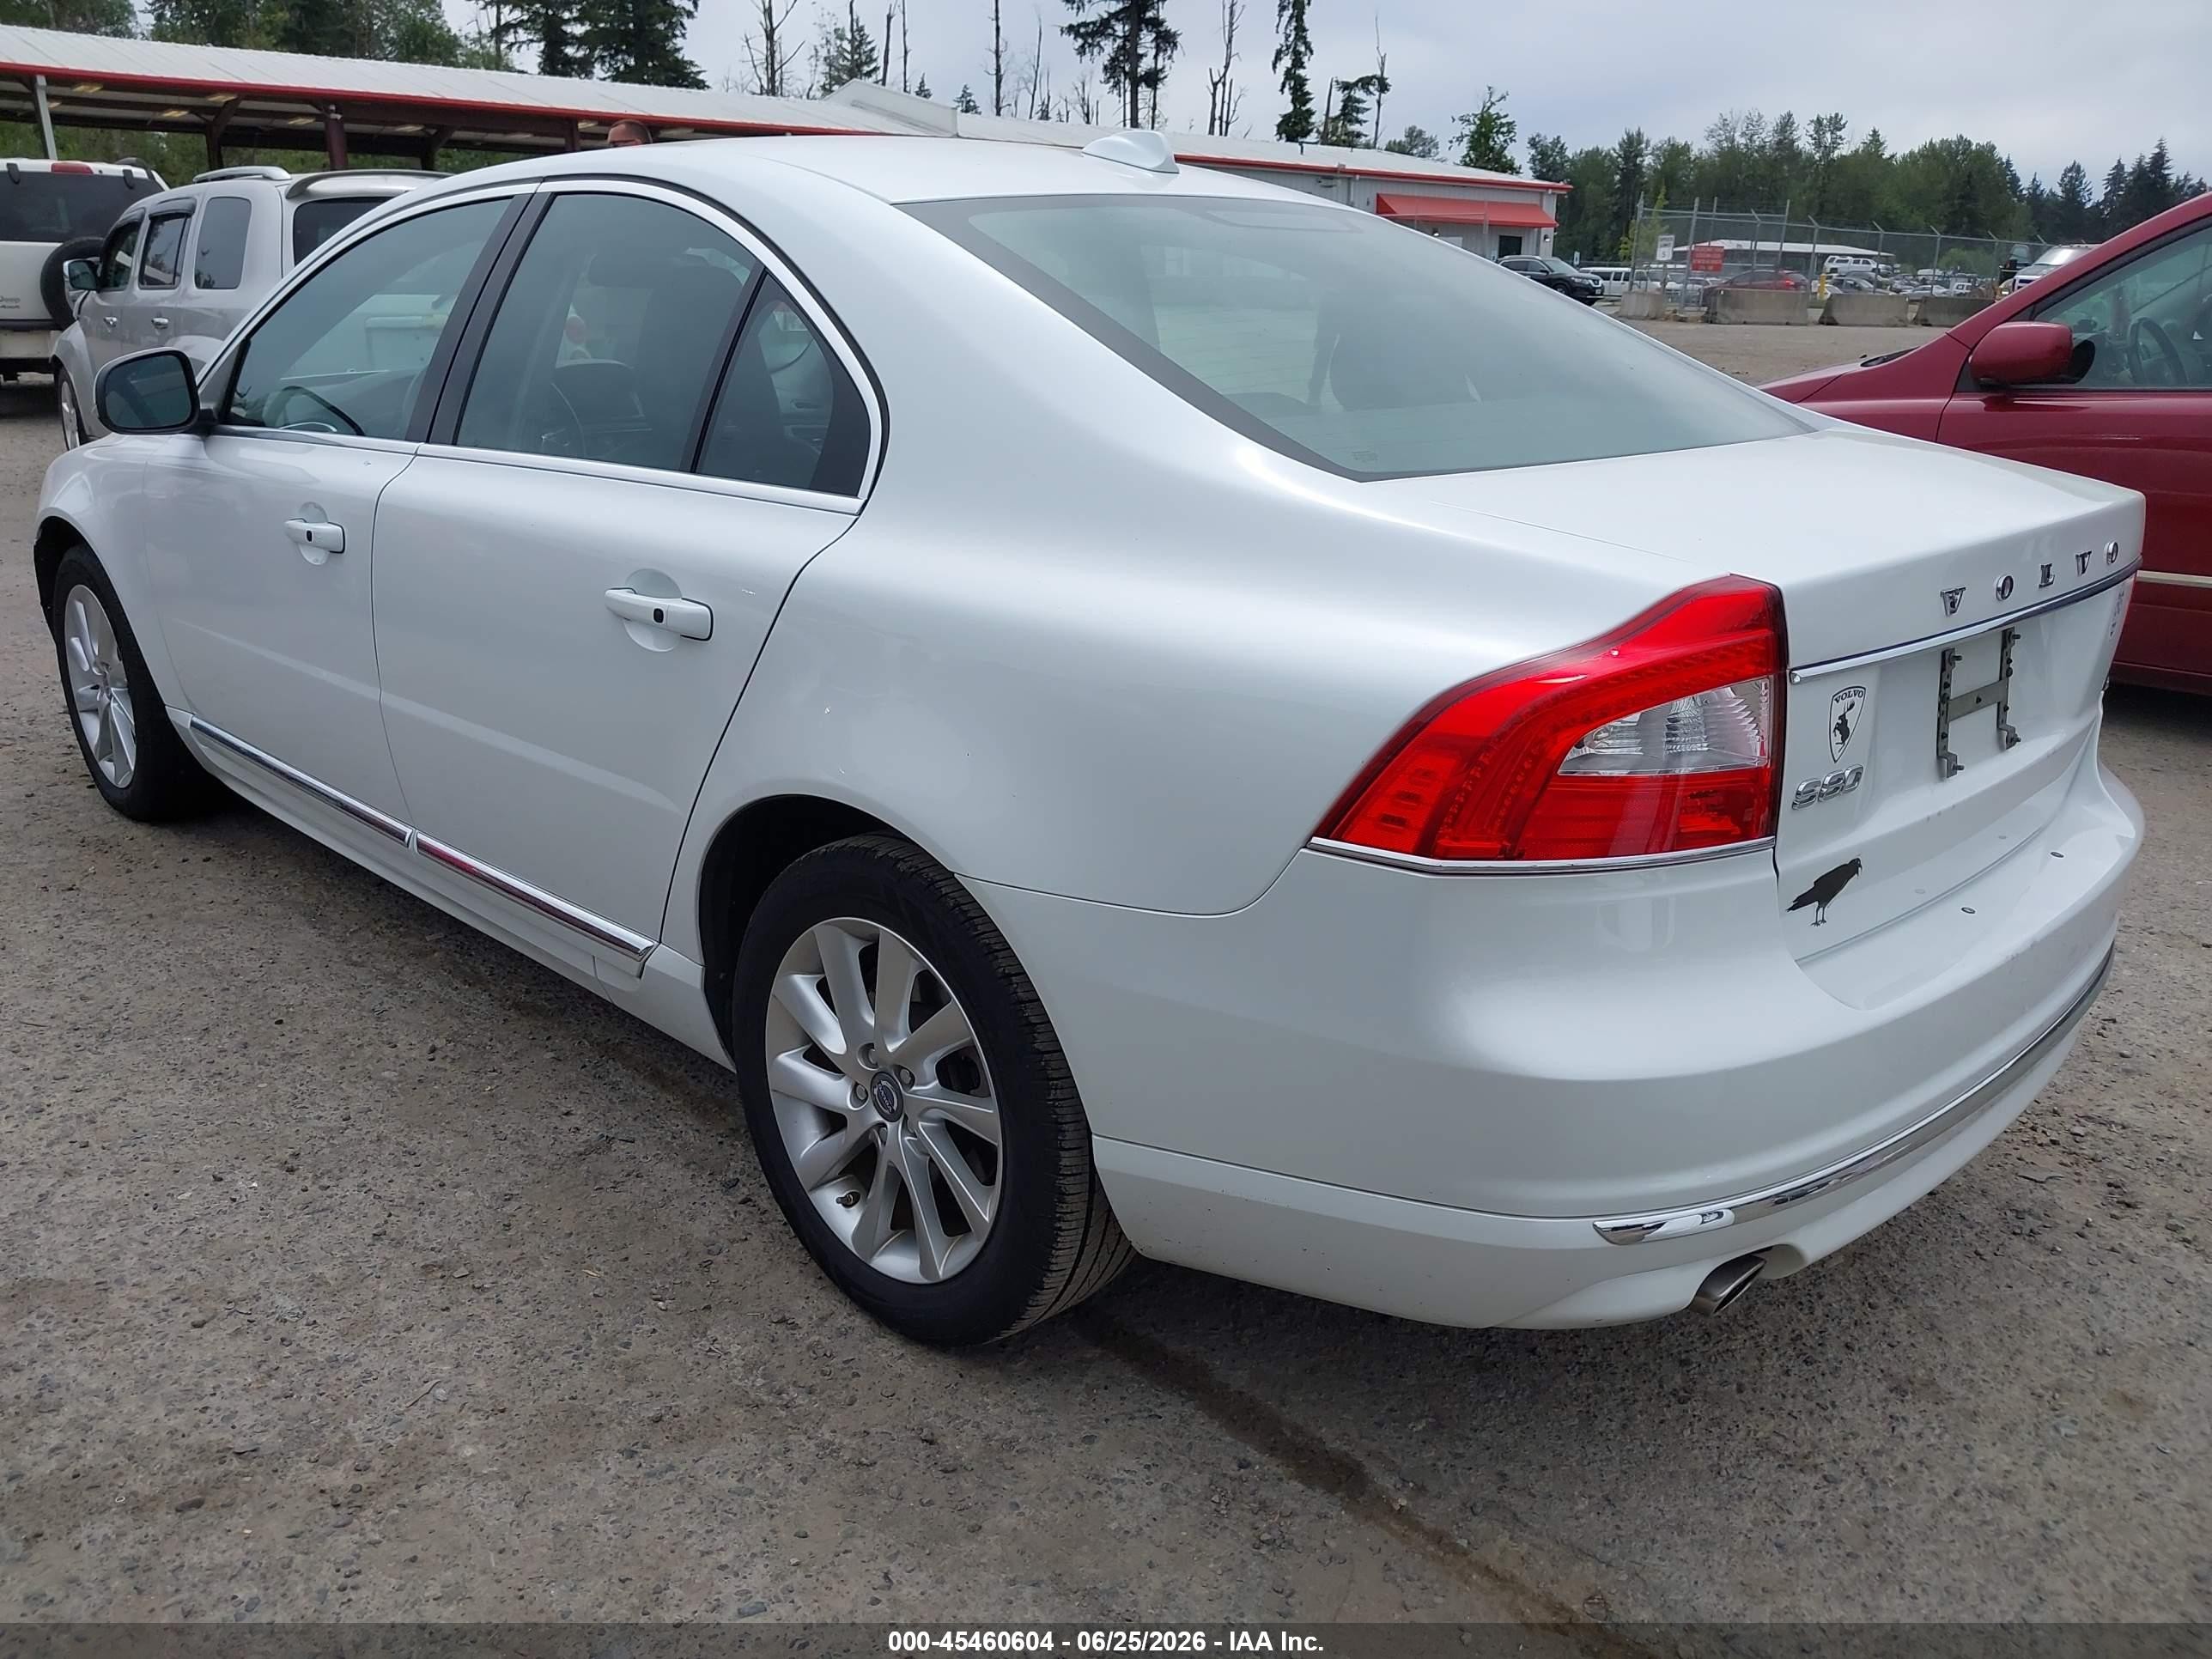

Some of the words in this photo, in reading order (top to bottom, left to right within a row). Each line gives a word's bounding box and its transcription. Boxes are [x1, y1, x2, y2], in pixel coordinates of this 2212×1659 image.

[1940, 540, 2119, 617] VOLVO
[1834, 690, 1864, 704] VOLVO
[1791, 764, 1864, 810] S80
